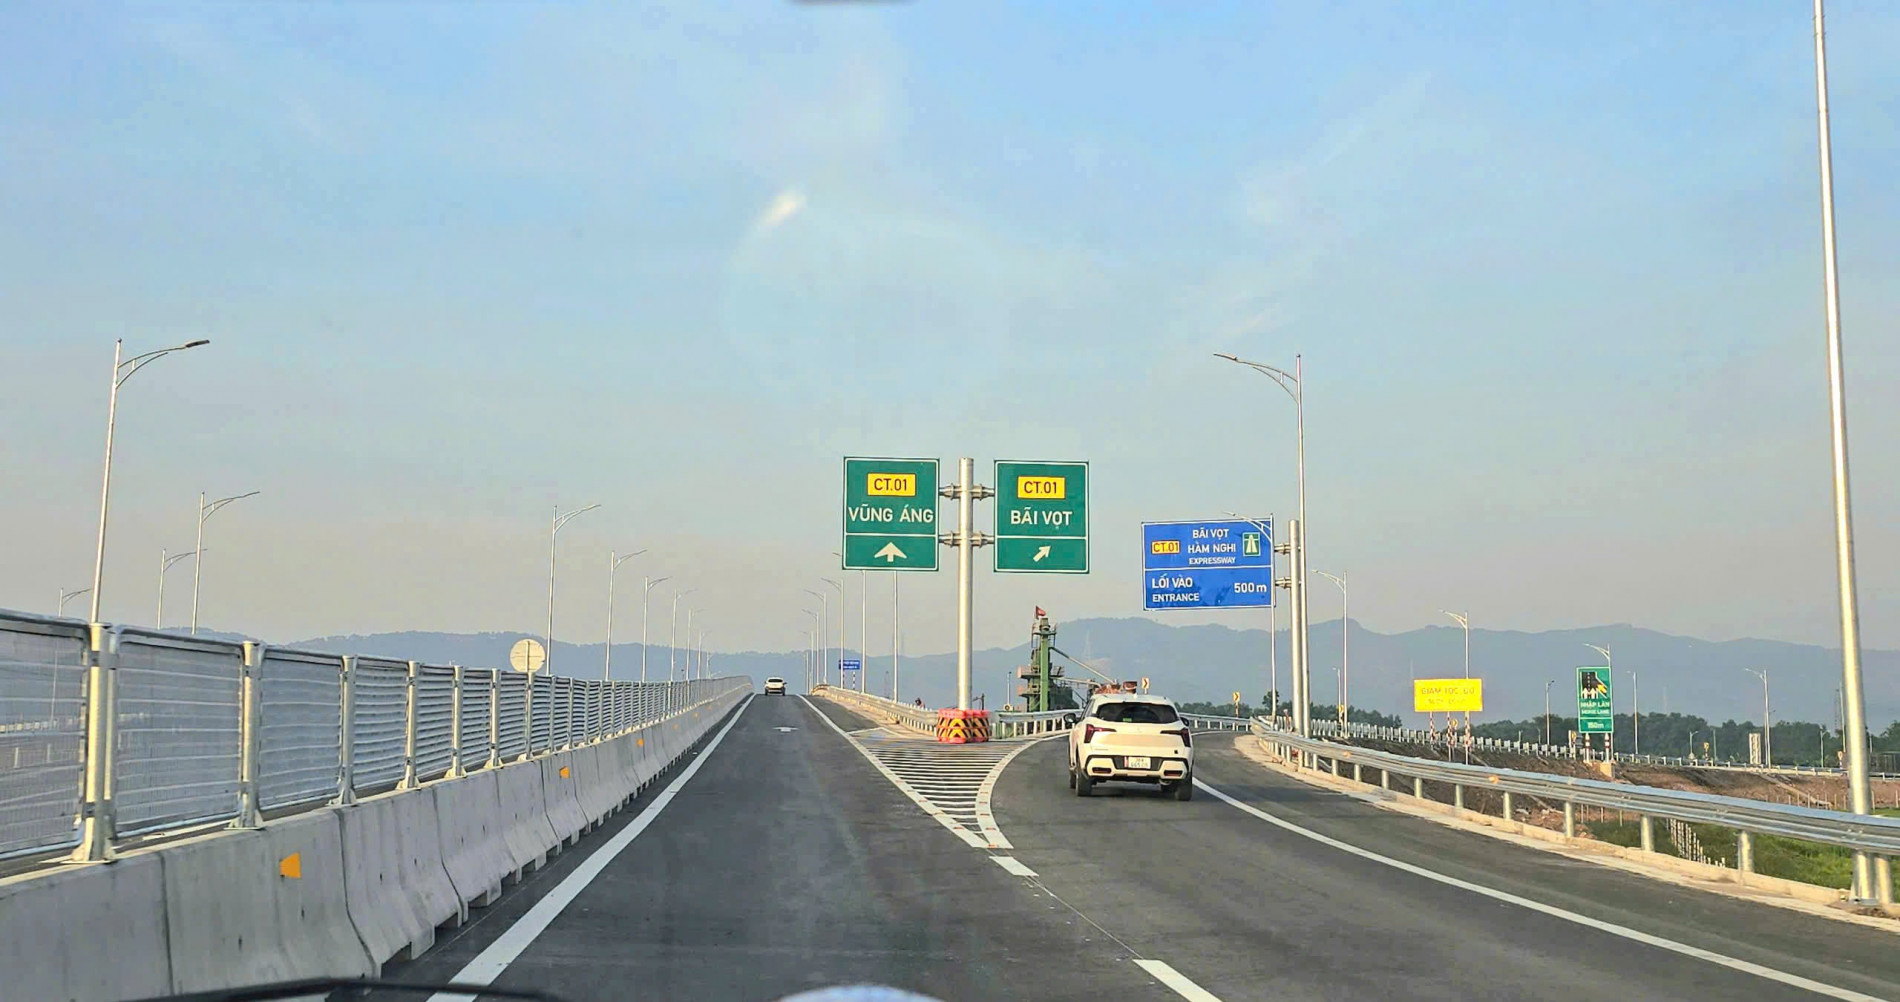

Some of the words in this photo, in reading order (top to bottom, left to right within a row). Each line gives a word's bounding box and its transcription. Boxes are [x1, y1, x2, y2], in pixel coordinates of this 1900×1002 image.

[874, 478, 908, 491] CT.01
[1023, 481, 1058, 494] CT.01
[848, 503, 893, 523] VŨNG
[900, 503, 934, 524] ÁNG
[1010, 506, 1038, 525] BÃI
[1043, 510, 1073, 530] VỌT
[1192, 527, 1209, 539] BÃI
[1210, 528, 1229, 541] VỌT
[1153, 542, 1179, 552] CT.01
[1187, 541, 1210, 554] HÀM
[1213, 543, 1236, 553] NGHI
[1188, 556, 1236, 565] EXPRESSWAY
[1151, 573, 1169, 589] LỐI
[1172, 574, 1193, 588] VÀO
[1234, 582, 1255, 593] 500
[1256, 584, 1267, 593] m
[1152, 592, 1200, 603] ENTRANCE
